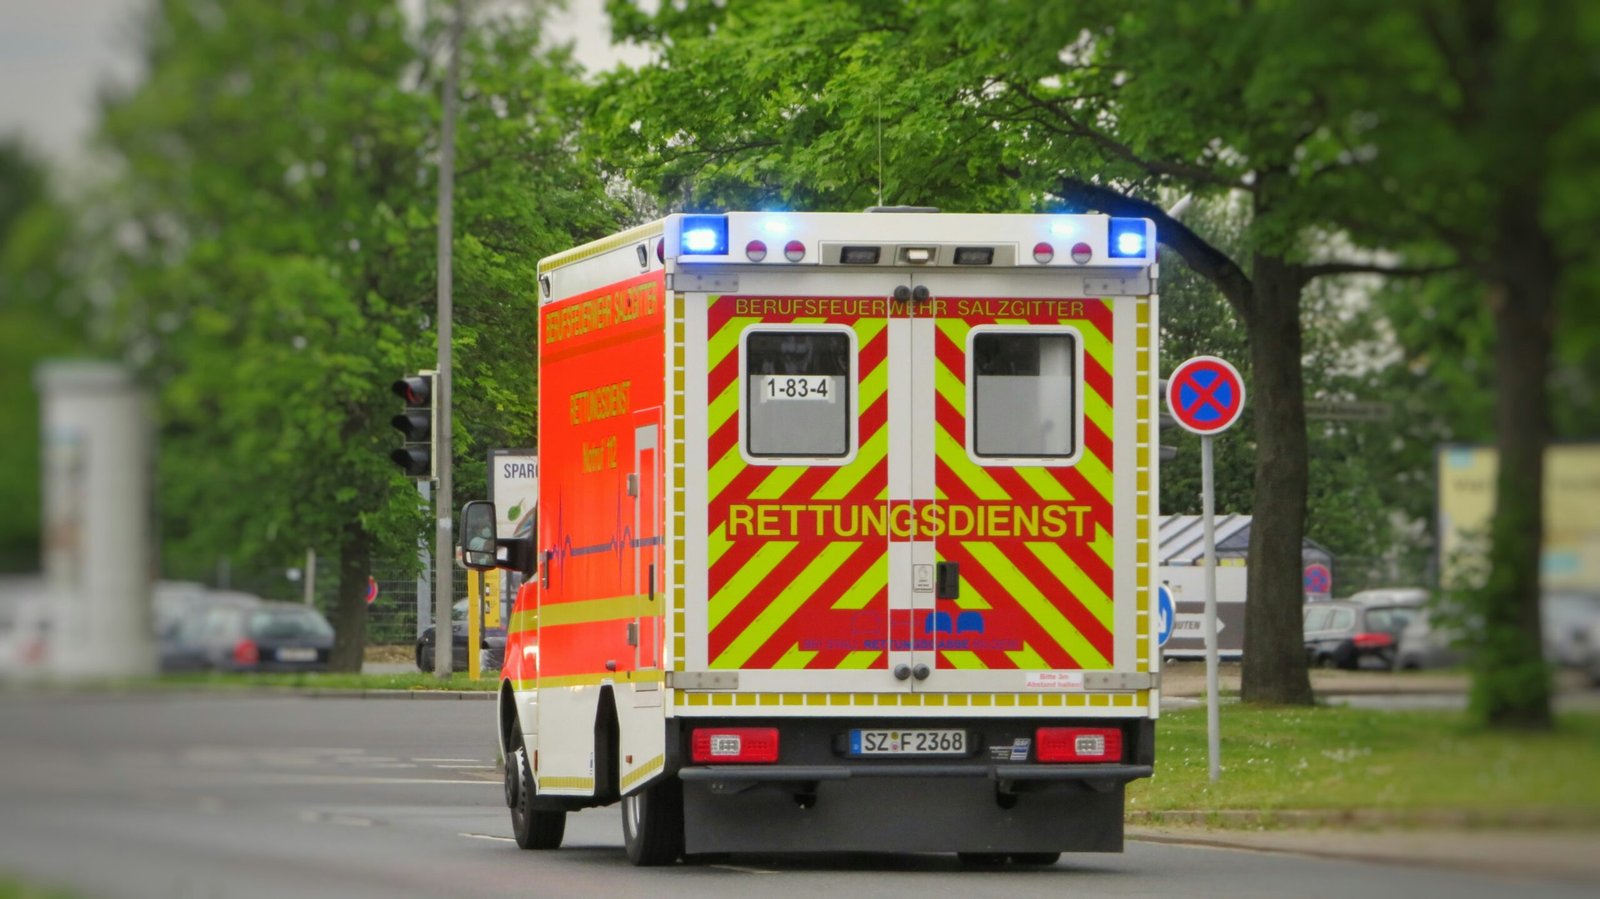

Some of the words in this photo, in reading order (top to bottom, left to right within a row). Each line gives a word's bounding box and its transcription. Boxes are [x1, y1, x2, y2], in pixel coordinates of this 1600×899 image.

[735, 299, 947, 316] BERUFSFEUERWEHR
[957, 300, 1085, 317] SALZGITTER
[766, 377, 829, 398] 1-83-4
[503, 463, 538, 479] SPAR
[728, 504, 1093, 537] RETTUNGSDIENST
[864, 732, 889, 751] SZ
[901, 732, 912, 751] F
[916, 732, 963, 751] 2368
